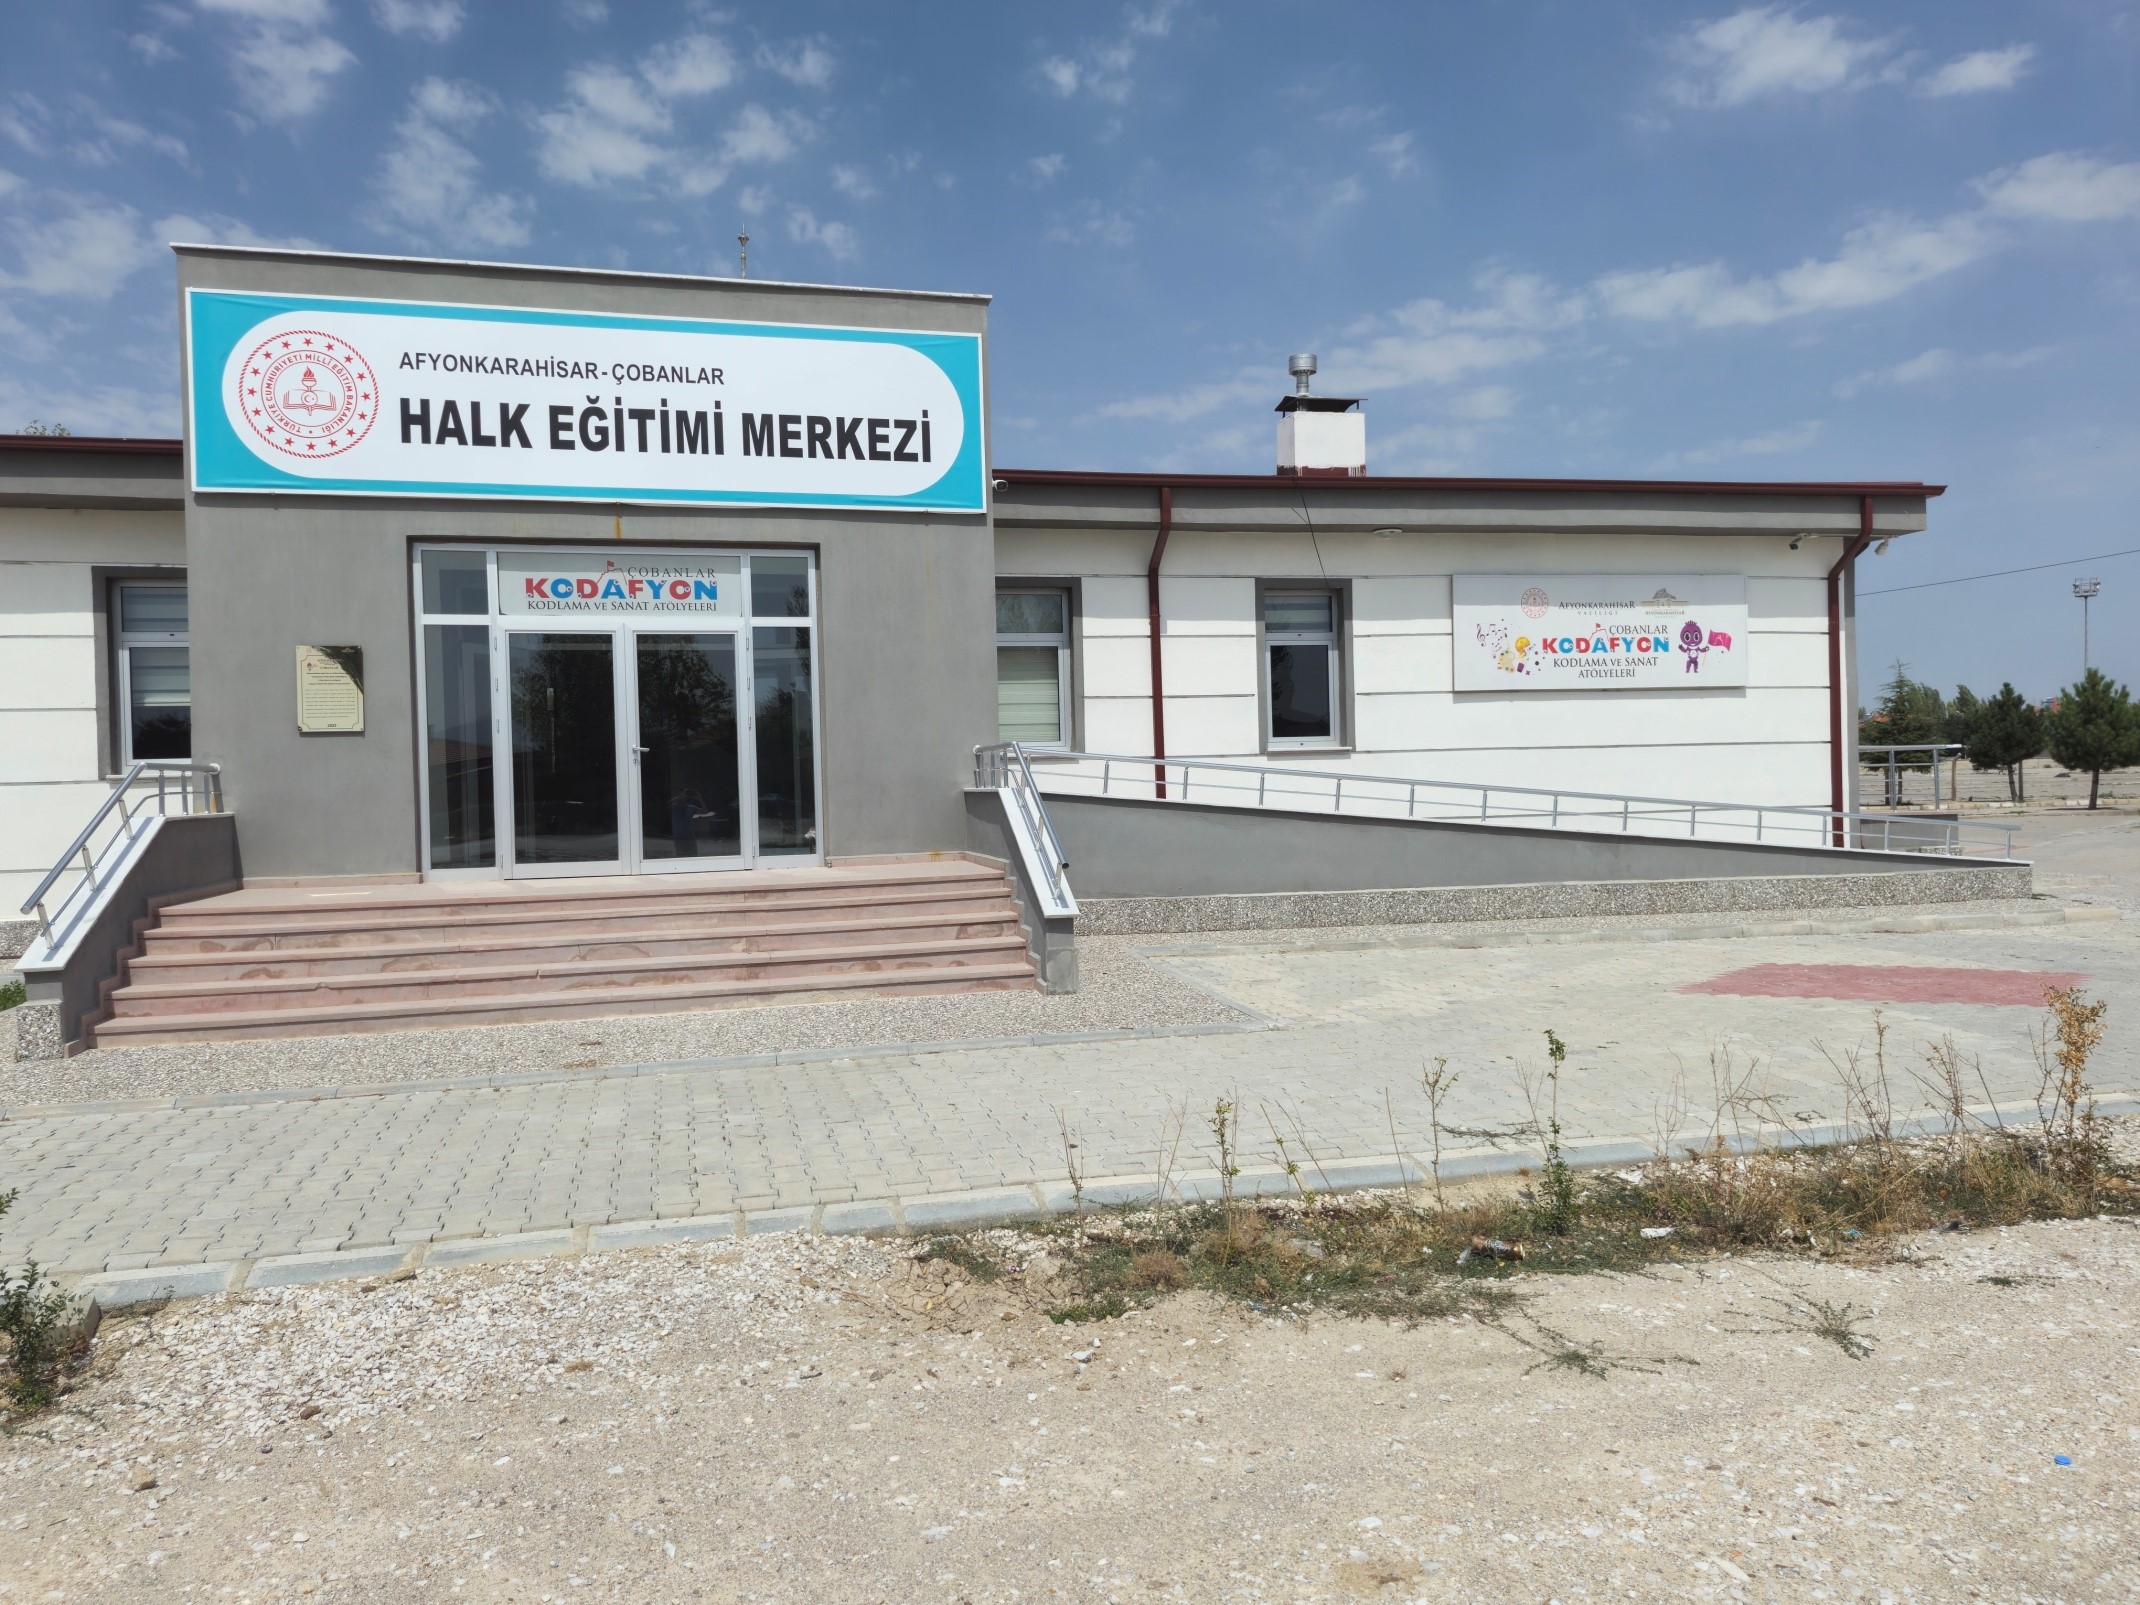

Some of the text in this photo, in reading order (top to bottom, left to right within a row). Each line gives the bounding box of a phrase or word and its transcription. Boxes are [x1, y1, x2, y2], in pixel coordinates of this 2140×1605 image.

[265, 353, 302, 401] CUMHURİYETİ
[331, 363, 353, 392] EĞİTİM
[399, 352, 725, 386] AFYONKARAHİSAR-ÇOBANLAR
[268, 404, 301, 433] TÜRKİYE
[321, 394, 354, 434] BAKANLIĞI
[400, 395, 932, 463] HALK EĞİTİMİ MERKEZİ
[627, 567, 716, 579] ÇOBANLAR
[525, 577, 718, 601] KODAFYON
[527, 601, 717, 612] KODLAMA VE SANAT ATÖLYELERİ
[1608, 625, 1668, 636] ÇOBANLAR
[1542, 636, 1670, 654] KODAFYON
[1553, 657, 1608, 668] KODLAMA
[1625, 657, 1659, 667] SANAT
[1578, 667, 1636, 679] ATÖLYELERİ
